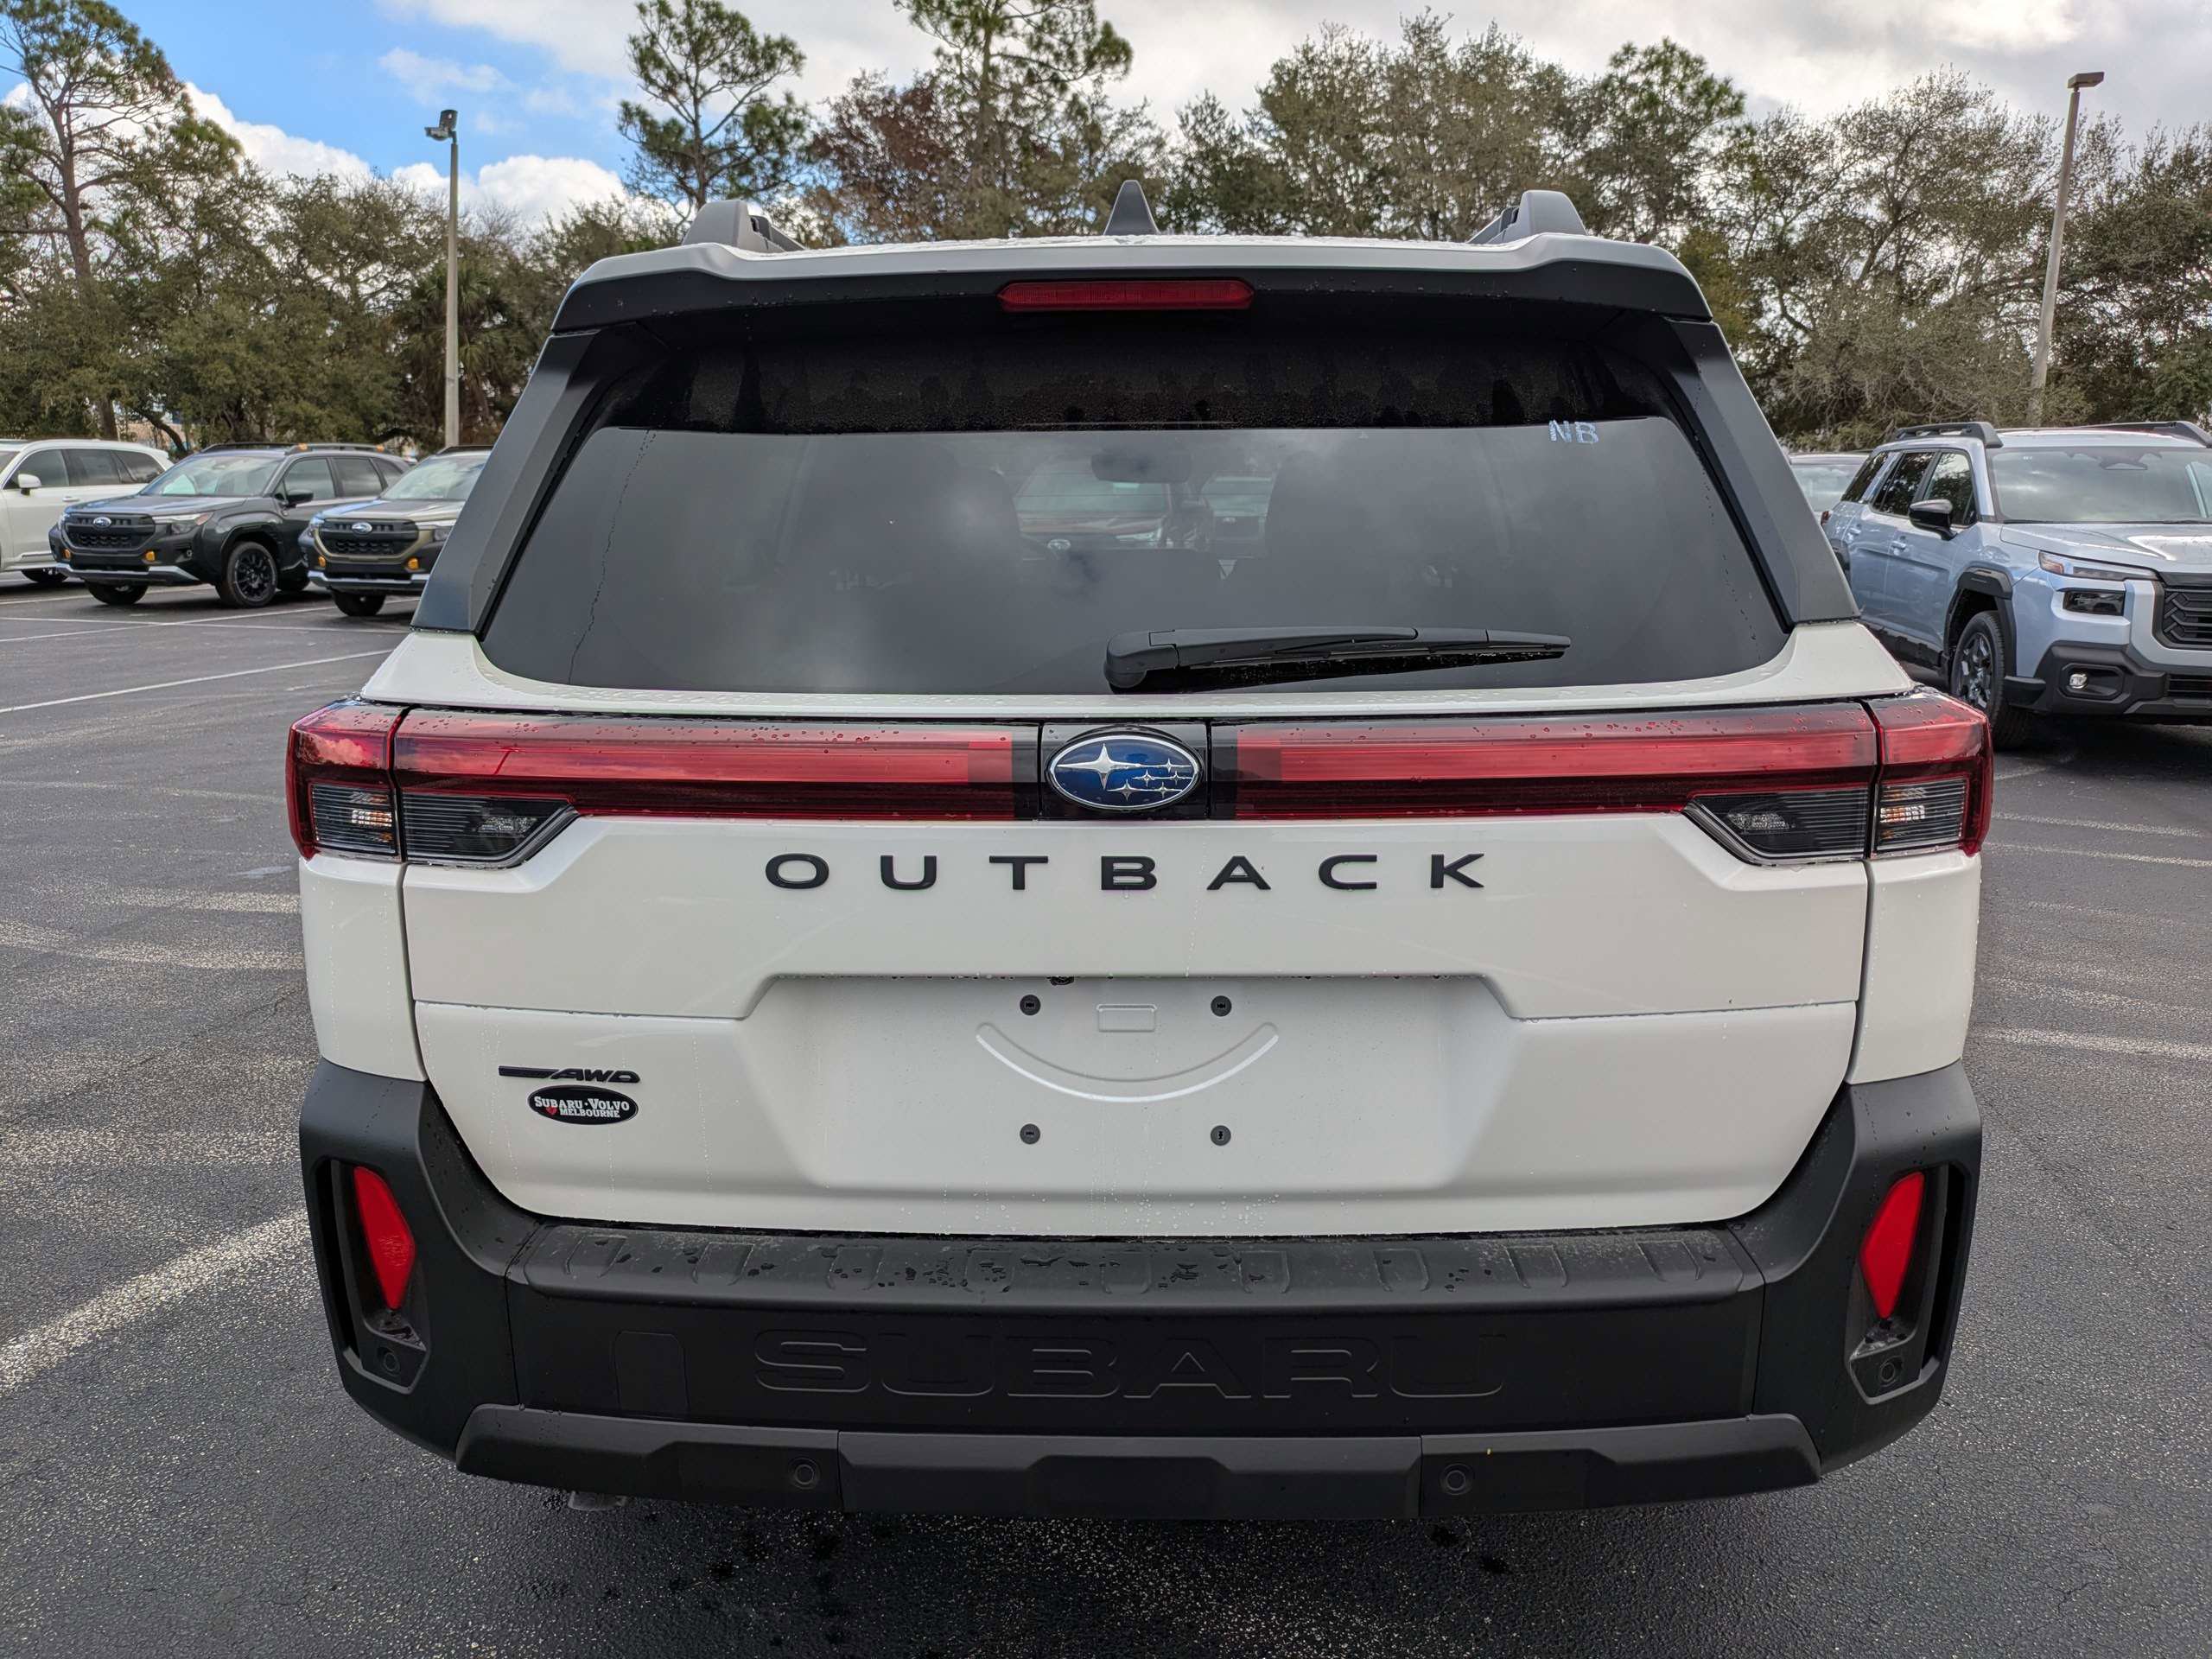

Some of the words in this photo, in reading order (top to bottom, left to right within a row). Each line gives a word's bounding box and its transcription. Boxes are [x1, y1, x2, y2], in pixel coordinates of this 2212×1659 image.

[1548, 420, 1599, 443] NB
[765, 853, 1484, 891] OUTBACK
[550, 1068, 641, 1083] AWD
[559, 1108, 621, 1118] MELBOURNE
[753, 1328, 1507, 1401] SUBARU
